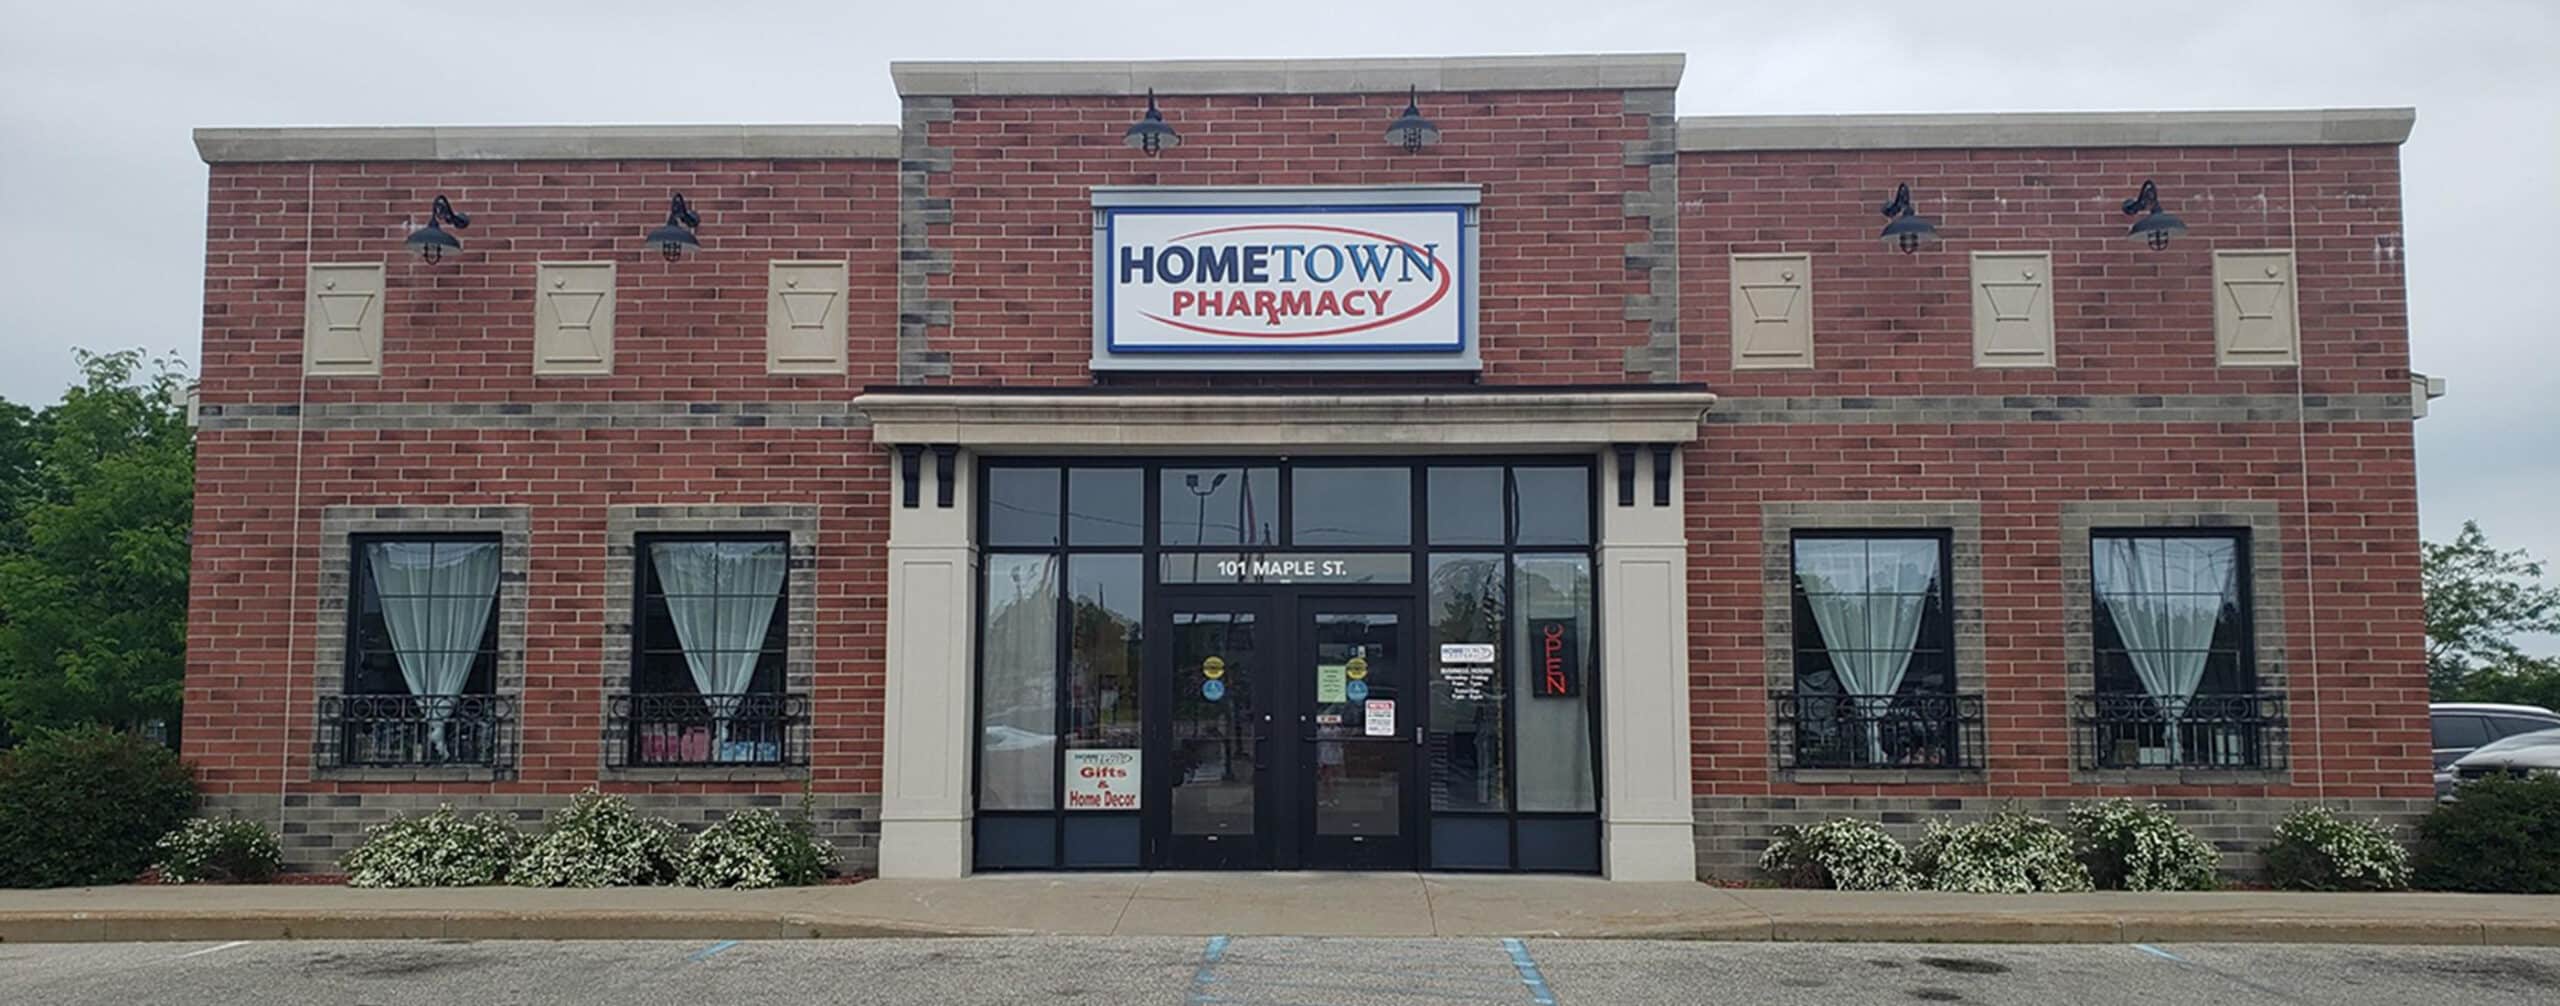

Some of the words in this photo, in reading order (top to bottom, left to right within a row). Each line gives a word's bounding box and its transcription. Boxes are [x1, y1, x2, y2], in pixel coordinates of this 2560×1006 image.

[1120, 244, 1439, 284] HOMETOWN
[1172, 290, 1393, 325] PHARMACY
[1217, 561, 1246, 576] 101
[1253, 561, 1315, 576] MAPLE
[1322, 561, 1347, 576] ST.
[1544, 623, 1566, 694] OPEN
[1080, 766, 1127, 778] Gifts
[1097, 780, 1110, 789] &
[1069, 790, 1101, 807] Home
[1104, 790, 1136, 807] Decor
